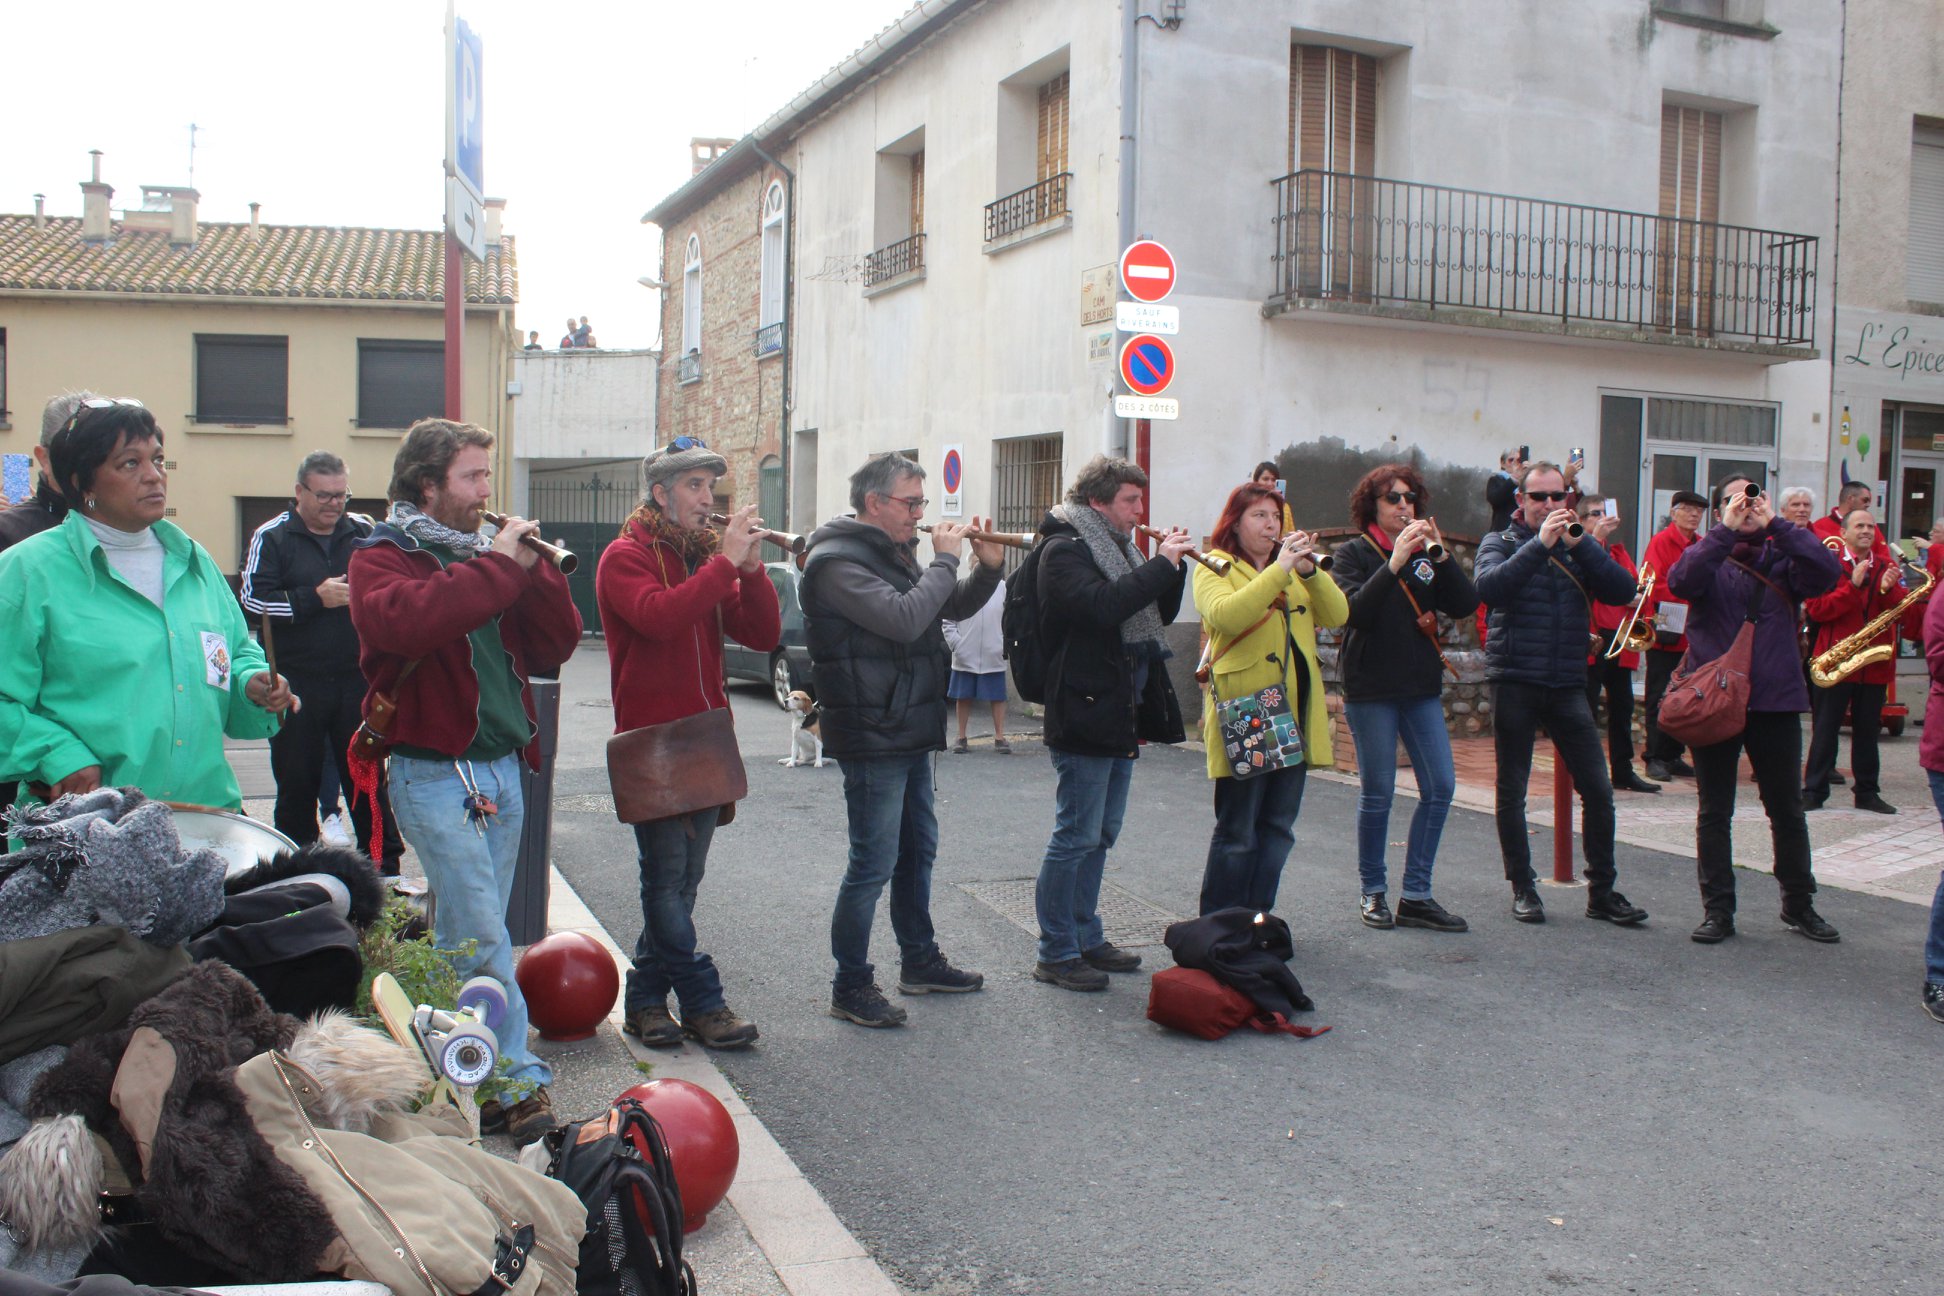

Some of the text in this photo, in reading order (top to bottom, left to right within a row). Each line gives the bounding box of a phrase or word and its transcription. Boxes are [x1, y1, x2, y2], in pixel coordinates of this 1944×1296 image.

[463, 39, 477, 149] P
[1096, 306, 1113, 320] HORTS
[1135, 307, 1161, 317] SAUF
[1120, 318, 1176, 330] RIVERAINS
[1118, 401, 1136, 411] DES
[1139, 403, 1145, 412] 2
